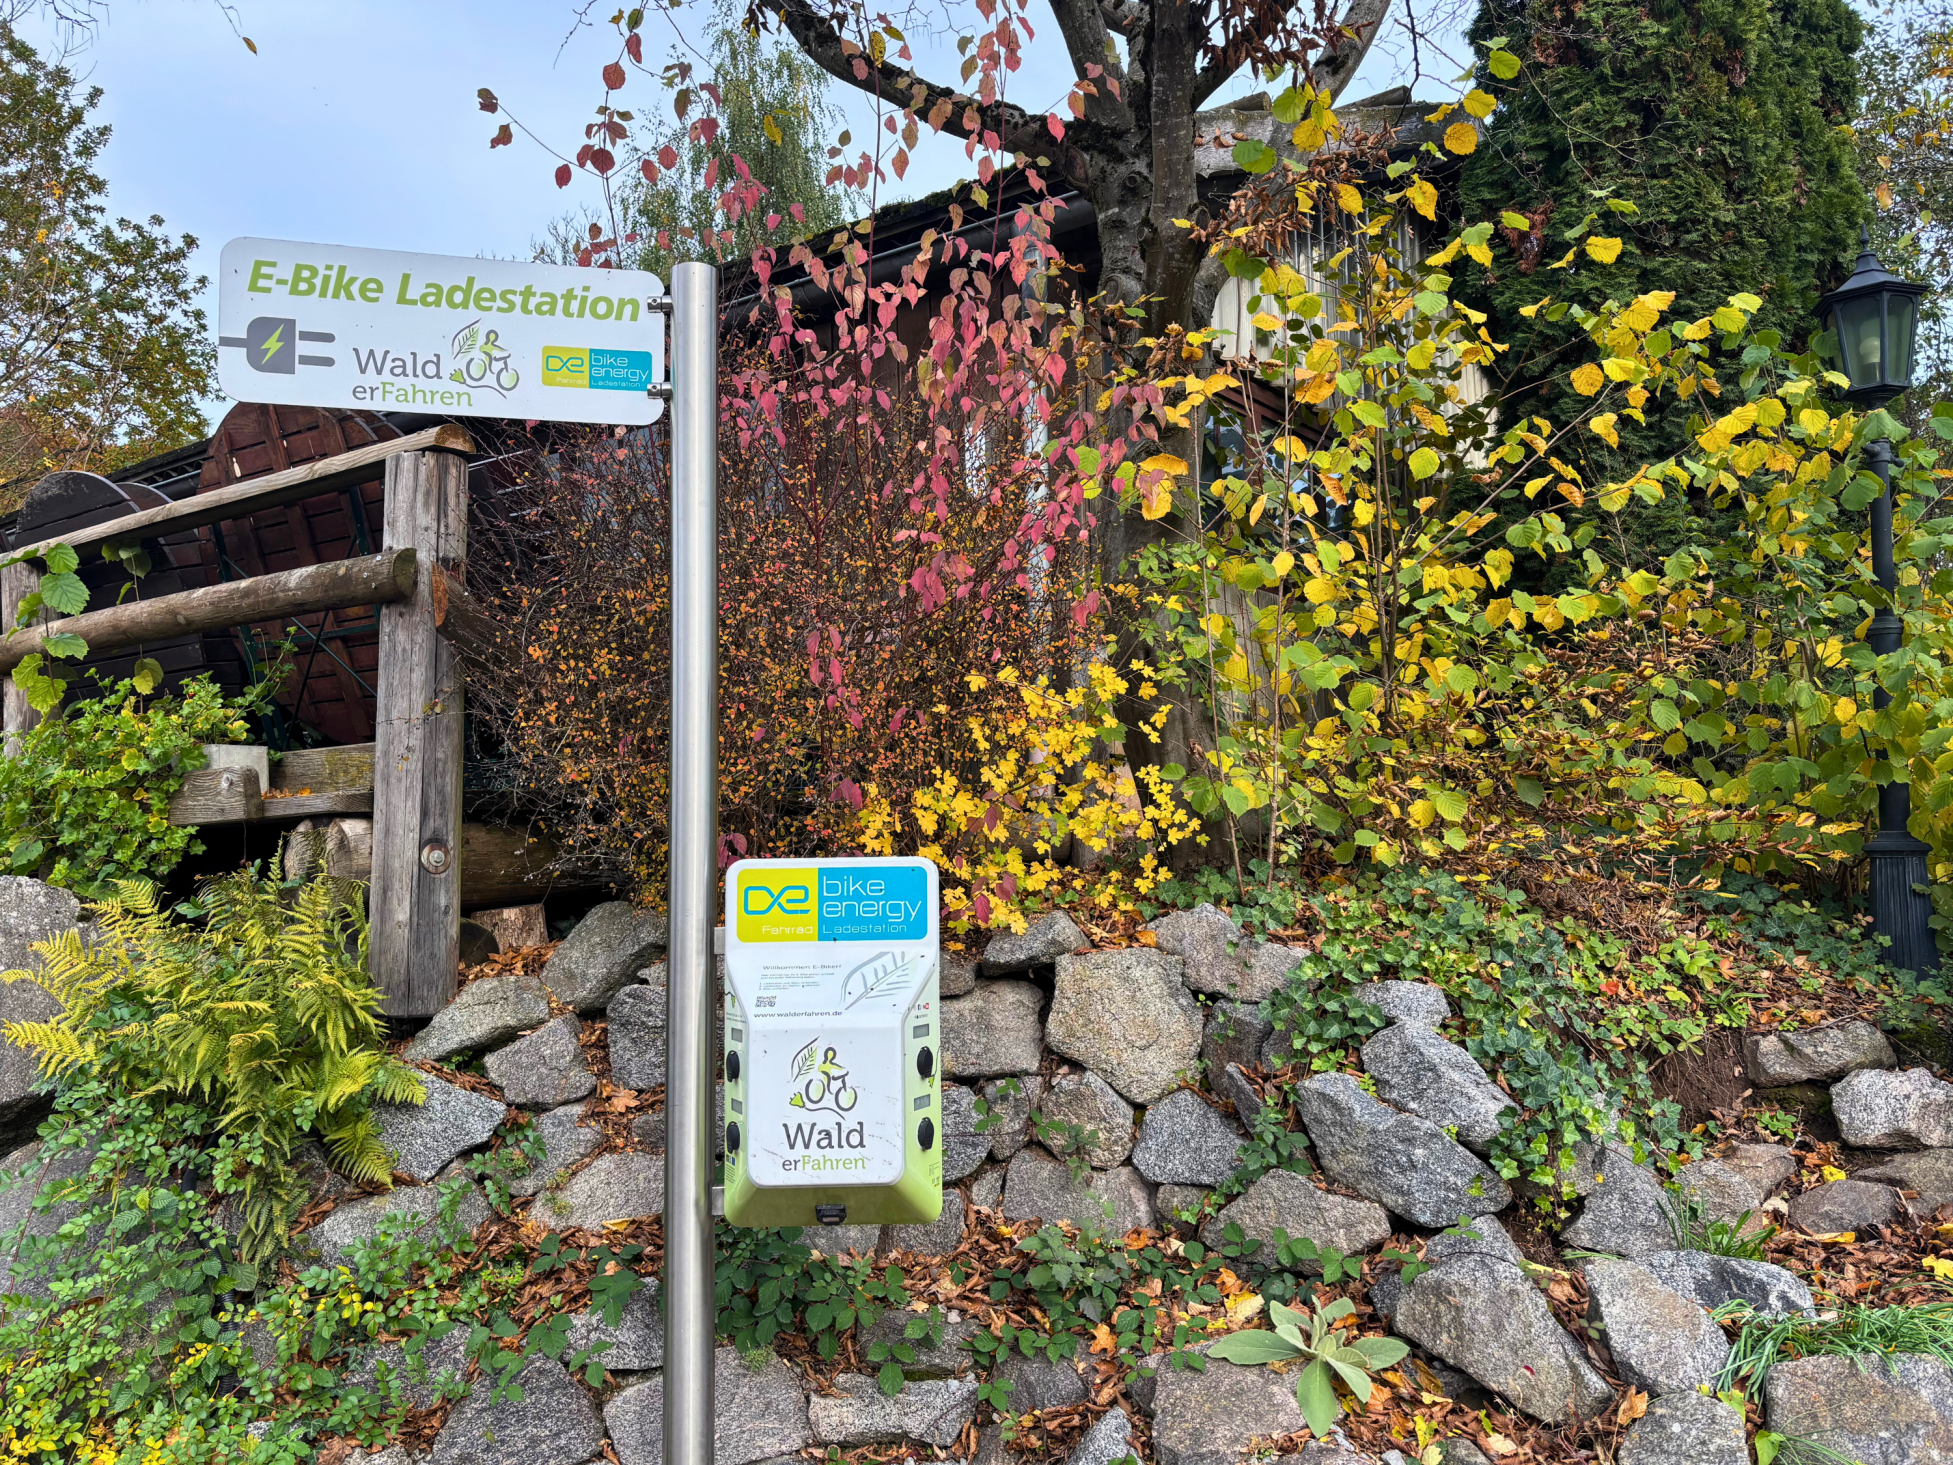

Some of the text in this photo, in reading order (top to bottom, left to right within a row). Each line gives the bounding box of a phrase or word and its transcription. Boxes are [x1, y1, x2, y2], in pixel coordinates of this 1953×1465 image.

[247, 259, 641, 322] E-Bike Ladestation
[352, 347, 443, 380] Wald
[591, 352, 629, 367] bike
[556, 376, 641, 388] Fahrrad Ladestation
[591, 367, 650, 382] energy
[352, 381, 473, 407] erFahren
[823, 875, 885, 896] bike
[823, 900, 922, 922] energy
[762, 924, 907, 935] Fahrrad Ladestation
[782, 1121, 866, 1150] Wald
[782, 1154, 866, 1172] erFahren
